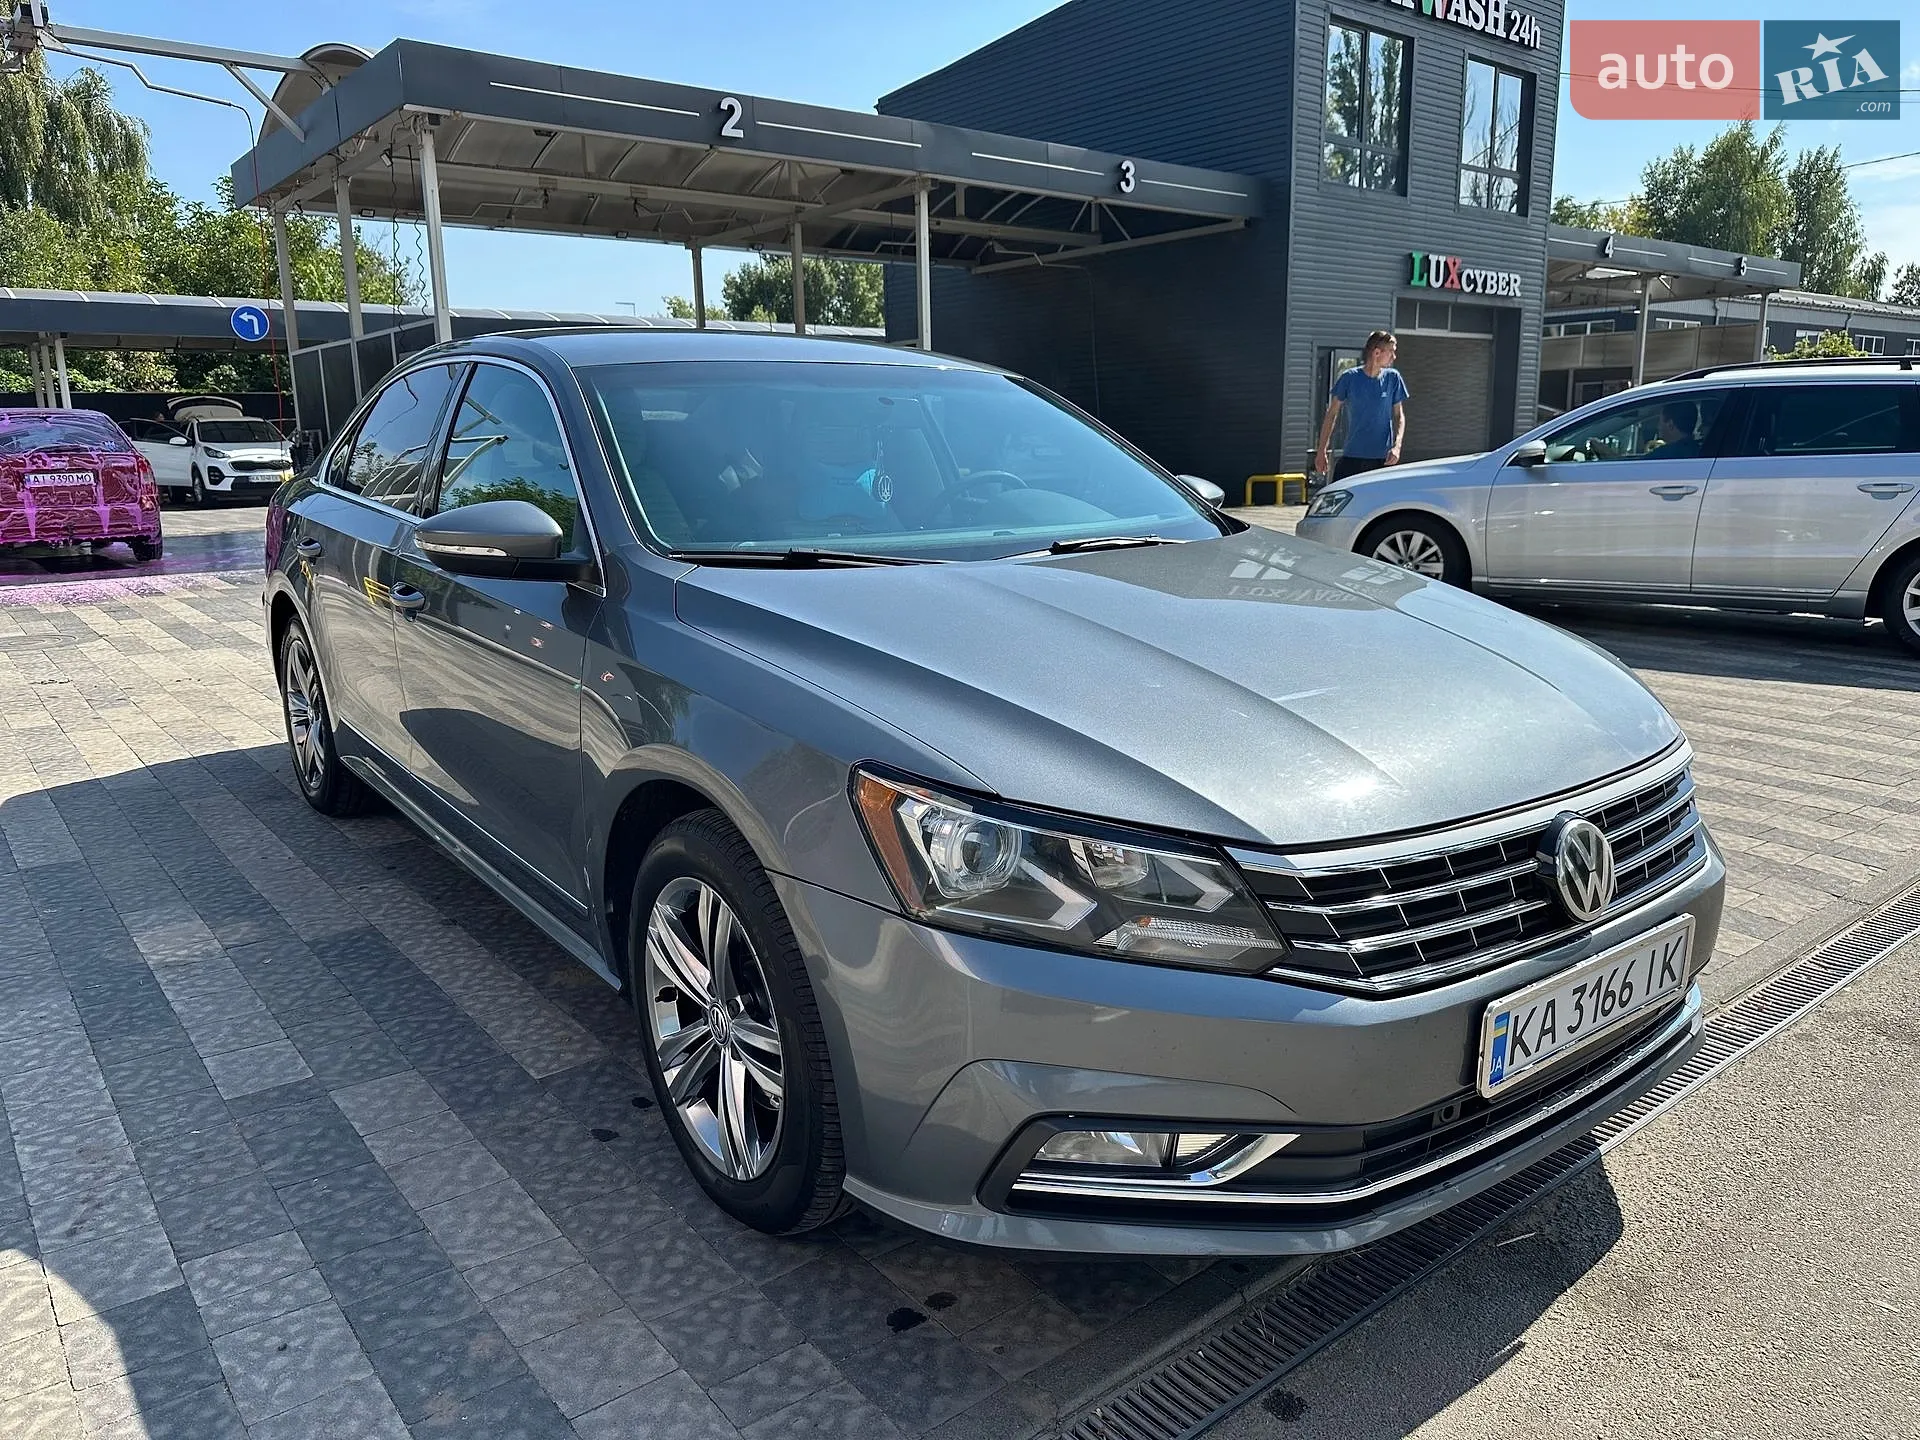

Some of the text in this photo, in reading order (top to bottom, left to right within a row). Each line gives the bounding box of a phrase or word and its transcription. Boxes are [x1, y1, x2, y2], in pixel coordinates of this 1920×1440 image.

[1509, 10, 1541, 49] 24h
[720, 96, 744, 138] 2
[1120, 160, 1136, 193] 3
[1605, 235, 1613, 258] 4
[1740, 256, 1747, 276] 5
[49, 474, 75, 483] 9390
[76, 473, 91, 483] MO
[1508, 936, 1684, 1066] KA 3166 IK
